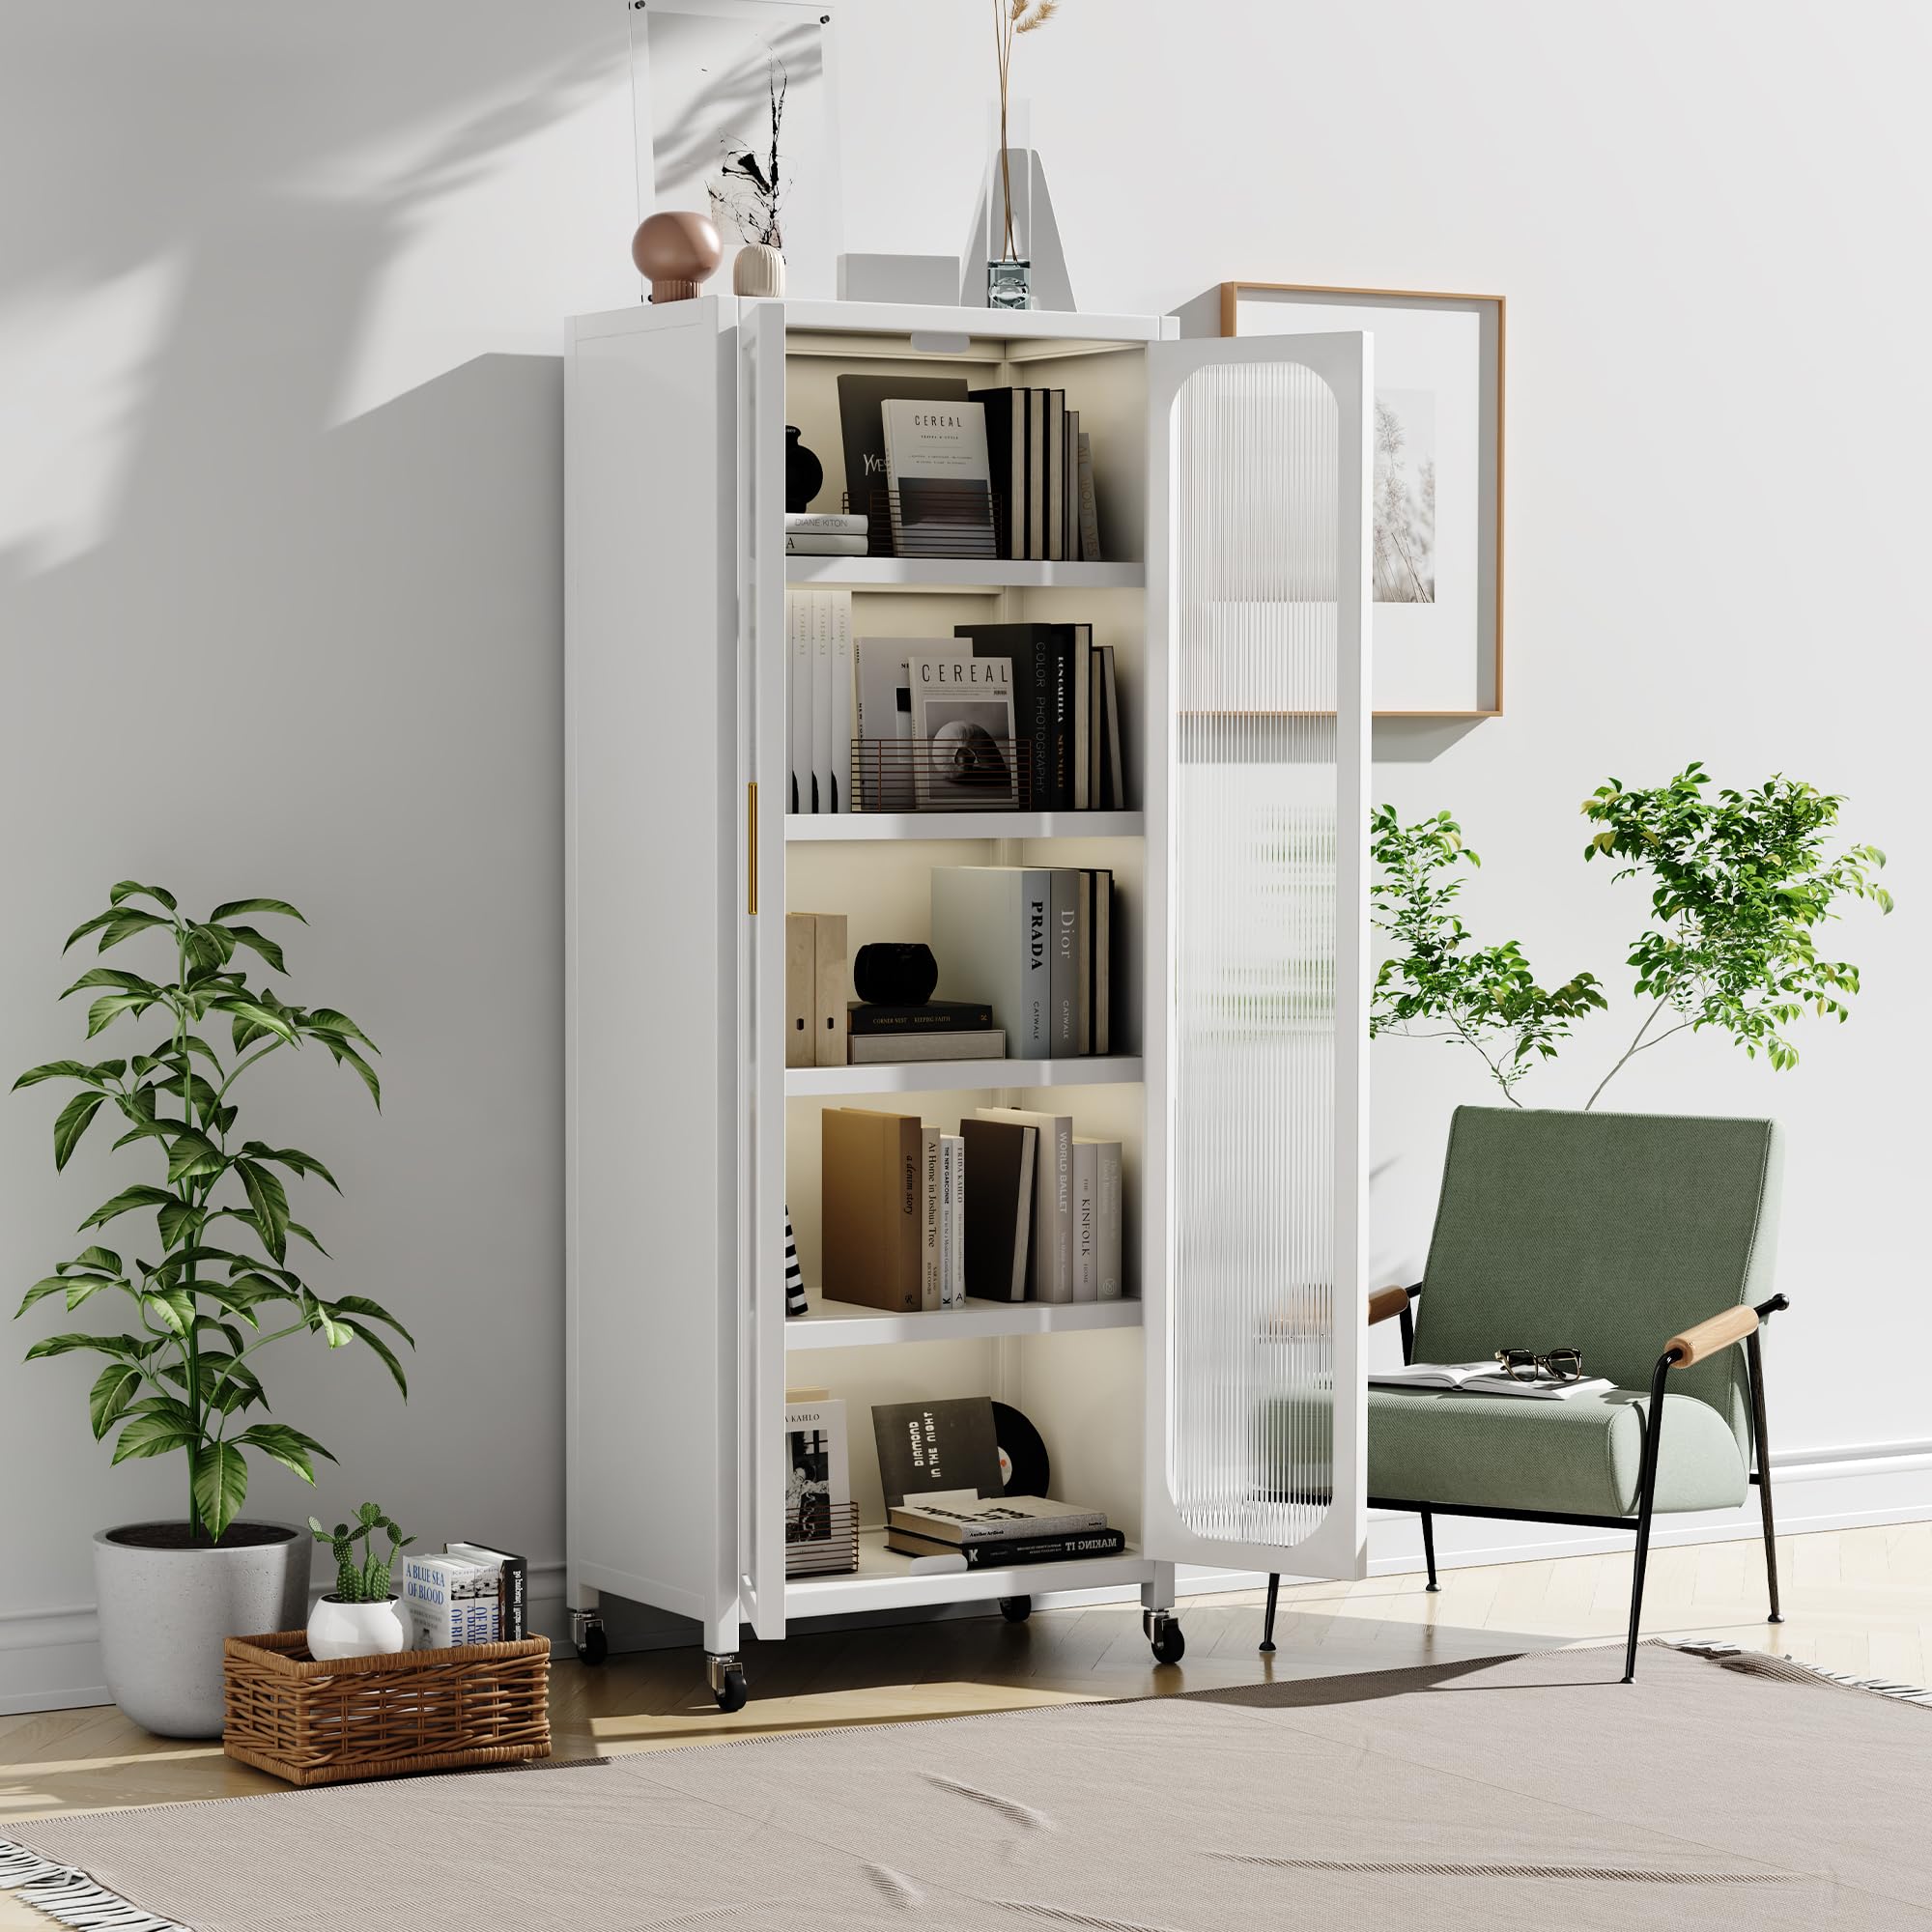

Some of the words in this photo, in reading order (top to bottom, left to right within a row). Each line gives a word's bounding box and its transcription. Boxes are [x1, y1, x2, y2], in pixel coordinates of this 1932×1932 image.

[914, 414, 963, 428] CEREAL
[794, 518, 821, 526] DIANE
[922, 664, 1009, 683] CEREAL
[1036, 641, 1045, 687] COLOR
[1036, 696, 1045, 793] PHOTOGRAPHY
[1031, 900, 1043, 971] PRADA
[1061, 909, 1075, 959] Dior
[927, 1142, 937, 1152] At
[1059, 1132, 1067, 1172] WORLD
[906, 1163, 916, 1190] denim
[927, 1155, 937, 1182] Home
[904, 1192, 914, 1215] story
[1059, 1175, 1067, 1213] BALLET
[927, 1194, 937, 1225] Joshua
[927, 1228, 937, 1248] Tree
[1081, 1198, 1090, 1257] KINFOLK
[791, 1413, 820, 1422] KAHLO
[923, 1411, 936, 1442] NIGHT
[908, 1421, 924, 1467] DIAMOND
[929, 1448, 940, 1466] THE
[931, 1467, 941, 1478] IN
[969, 1548, 979, 1562] K
[406, 1563, 412, 1577] A
[412, 1566, 431, 1582] BLUE
[432, 1570, 445, 1587] SEA
[408, 1581, 417, 1597] OF
[418, 1584, 444, 1605] BLOOD
[451, 1608, 463, 1624] OF
[474, 1606, 487, 1622] OF
